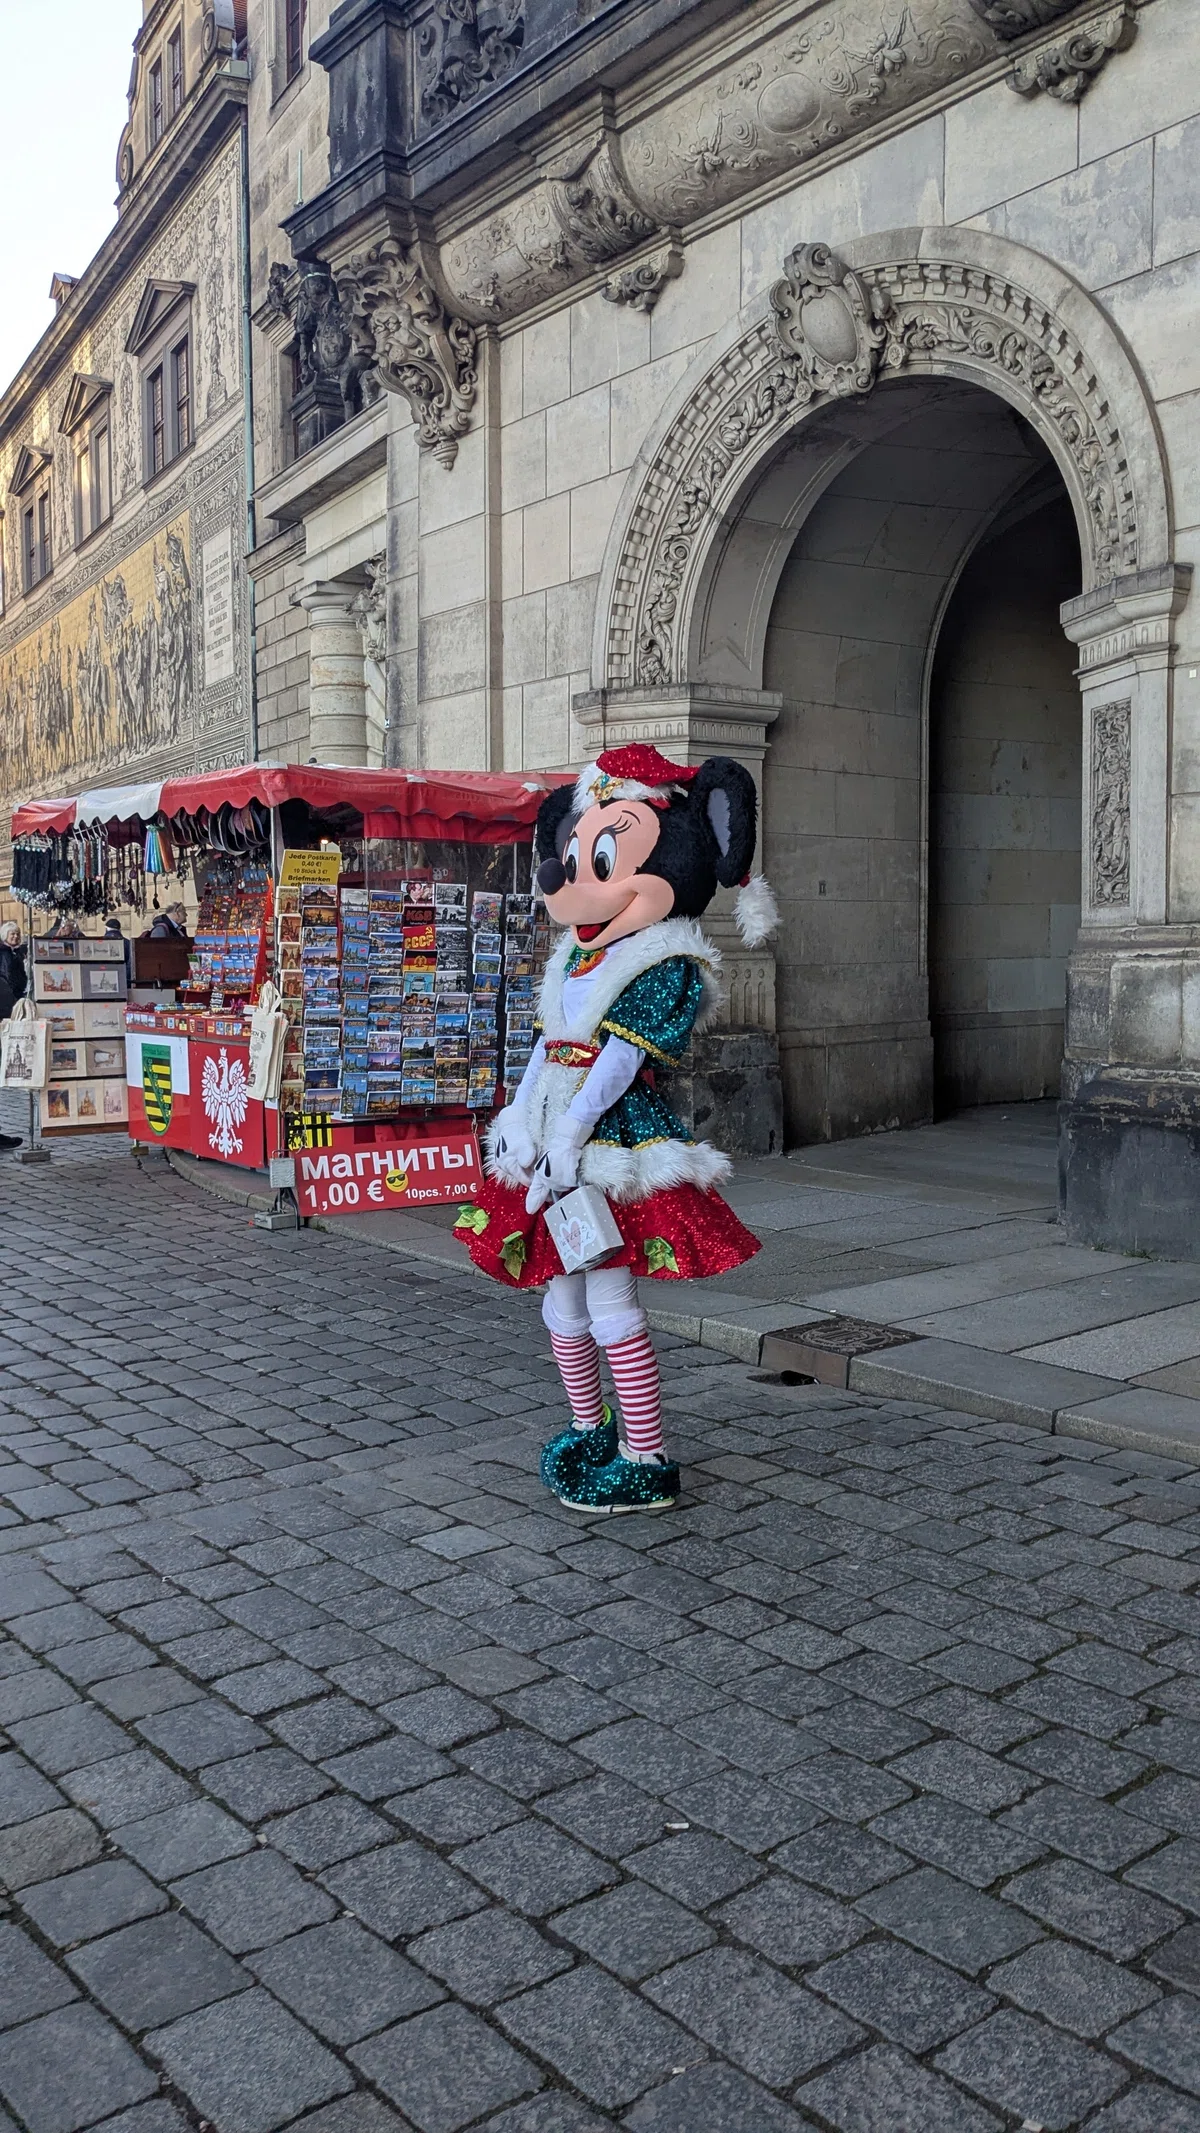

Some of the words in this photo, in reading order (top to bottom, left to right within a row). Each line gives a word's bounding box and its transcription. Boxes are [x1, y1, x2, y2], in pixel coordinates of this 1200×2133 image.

[307, 854, 337, 862] Postkarte
[406, 910, 433, 921] KGB
[304, 1181, 360, 1211] 1,00
[366, 1179, 385, 1203] €
[404, 1188, 442, 1201] 10pcs.
[444, 1184, 468, 1197] 7,00
[469, 1183, 478, 1193] €
